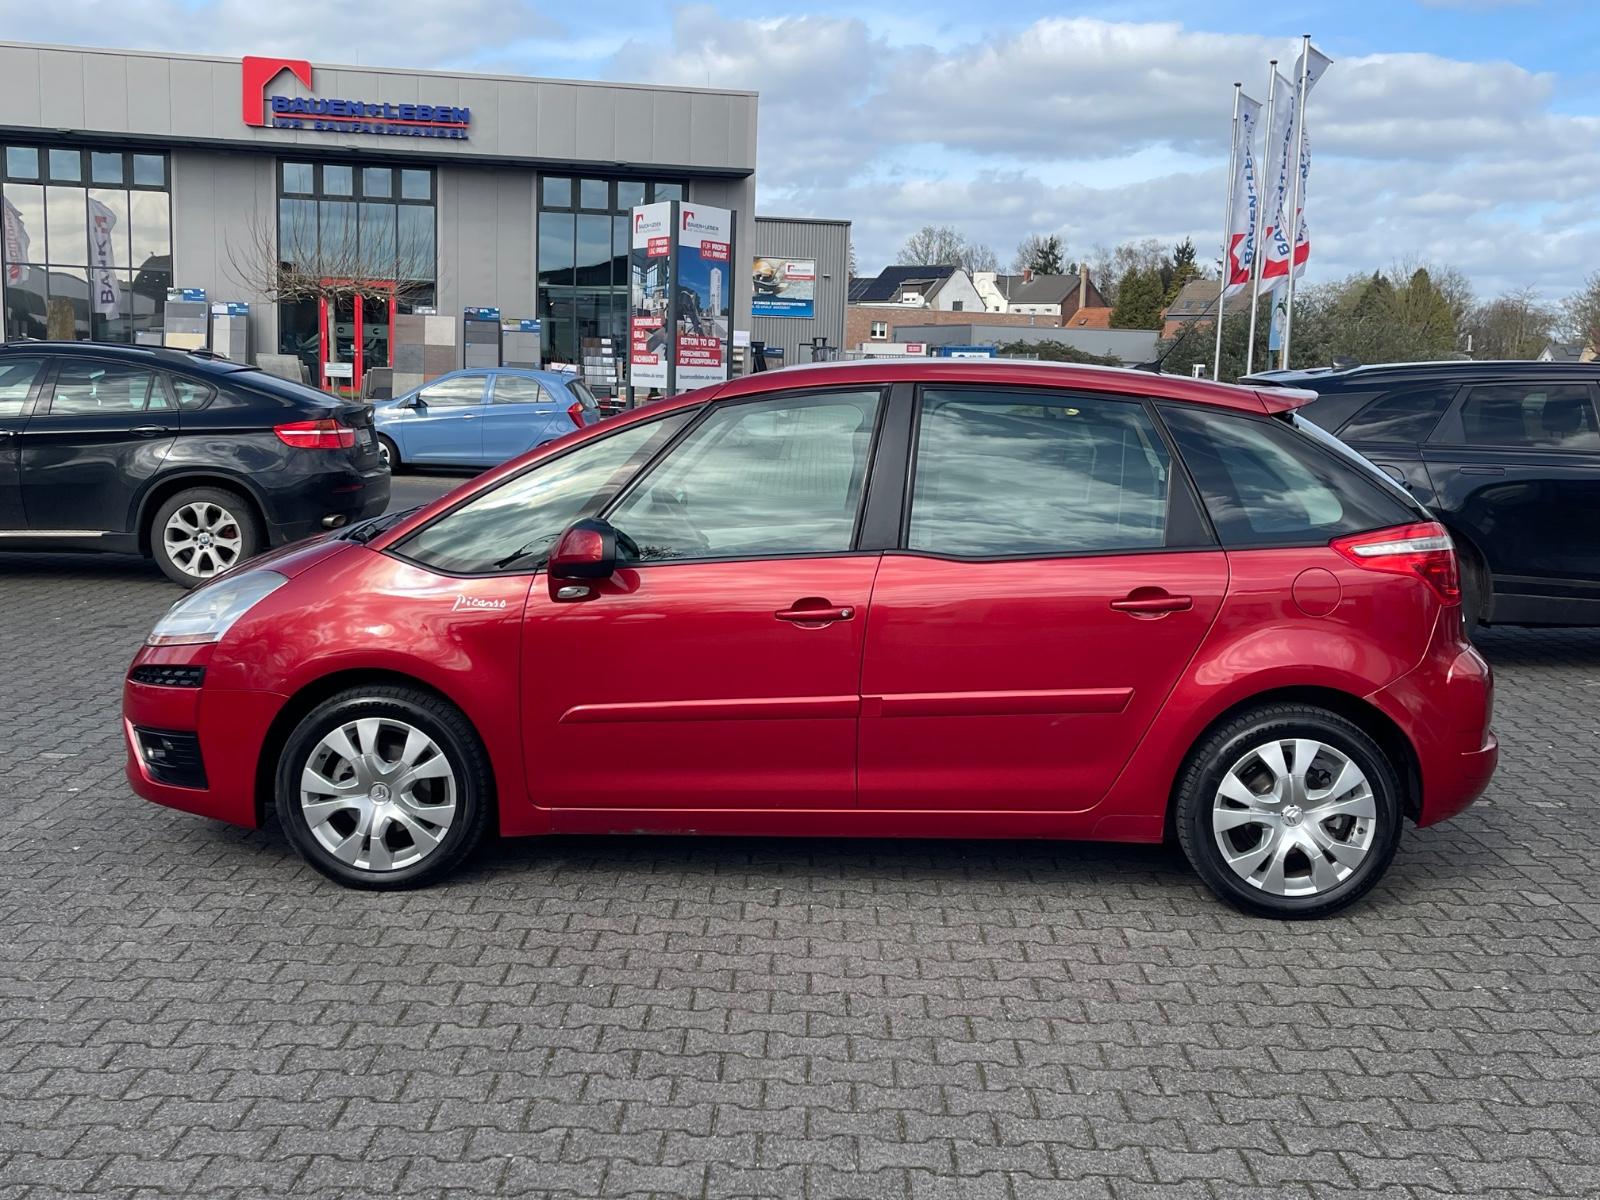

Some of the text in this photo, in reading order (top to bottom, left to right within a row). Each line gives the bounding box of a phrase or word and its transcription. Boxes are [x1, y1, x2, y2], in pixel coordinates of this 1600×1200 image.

[272, 95, 470, 123] BAUEN+LEBEN
[680, 337, 716, 347] BETON TO GO
[452, 593, 506, 611] Picasso
[1216, 721, 1297, 763] OODRIDE
